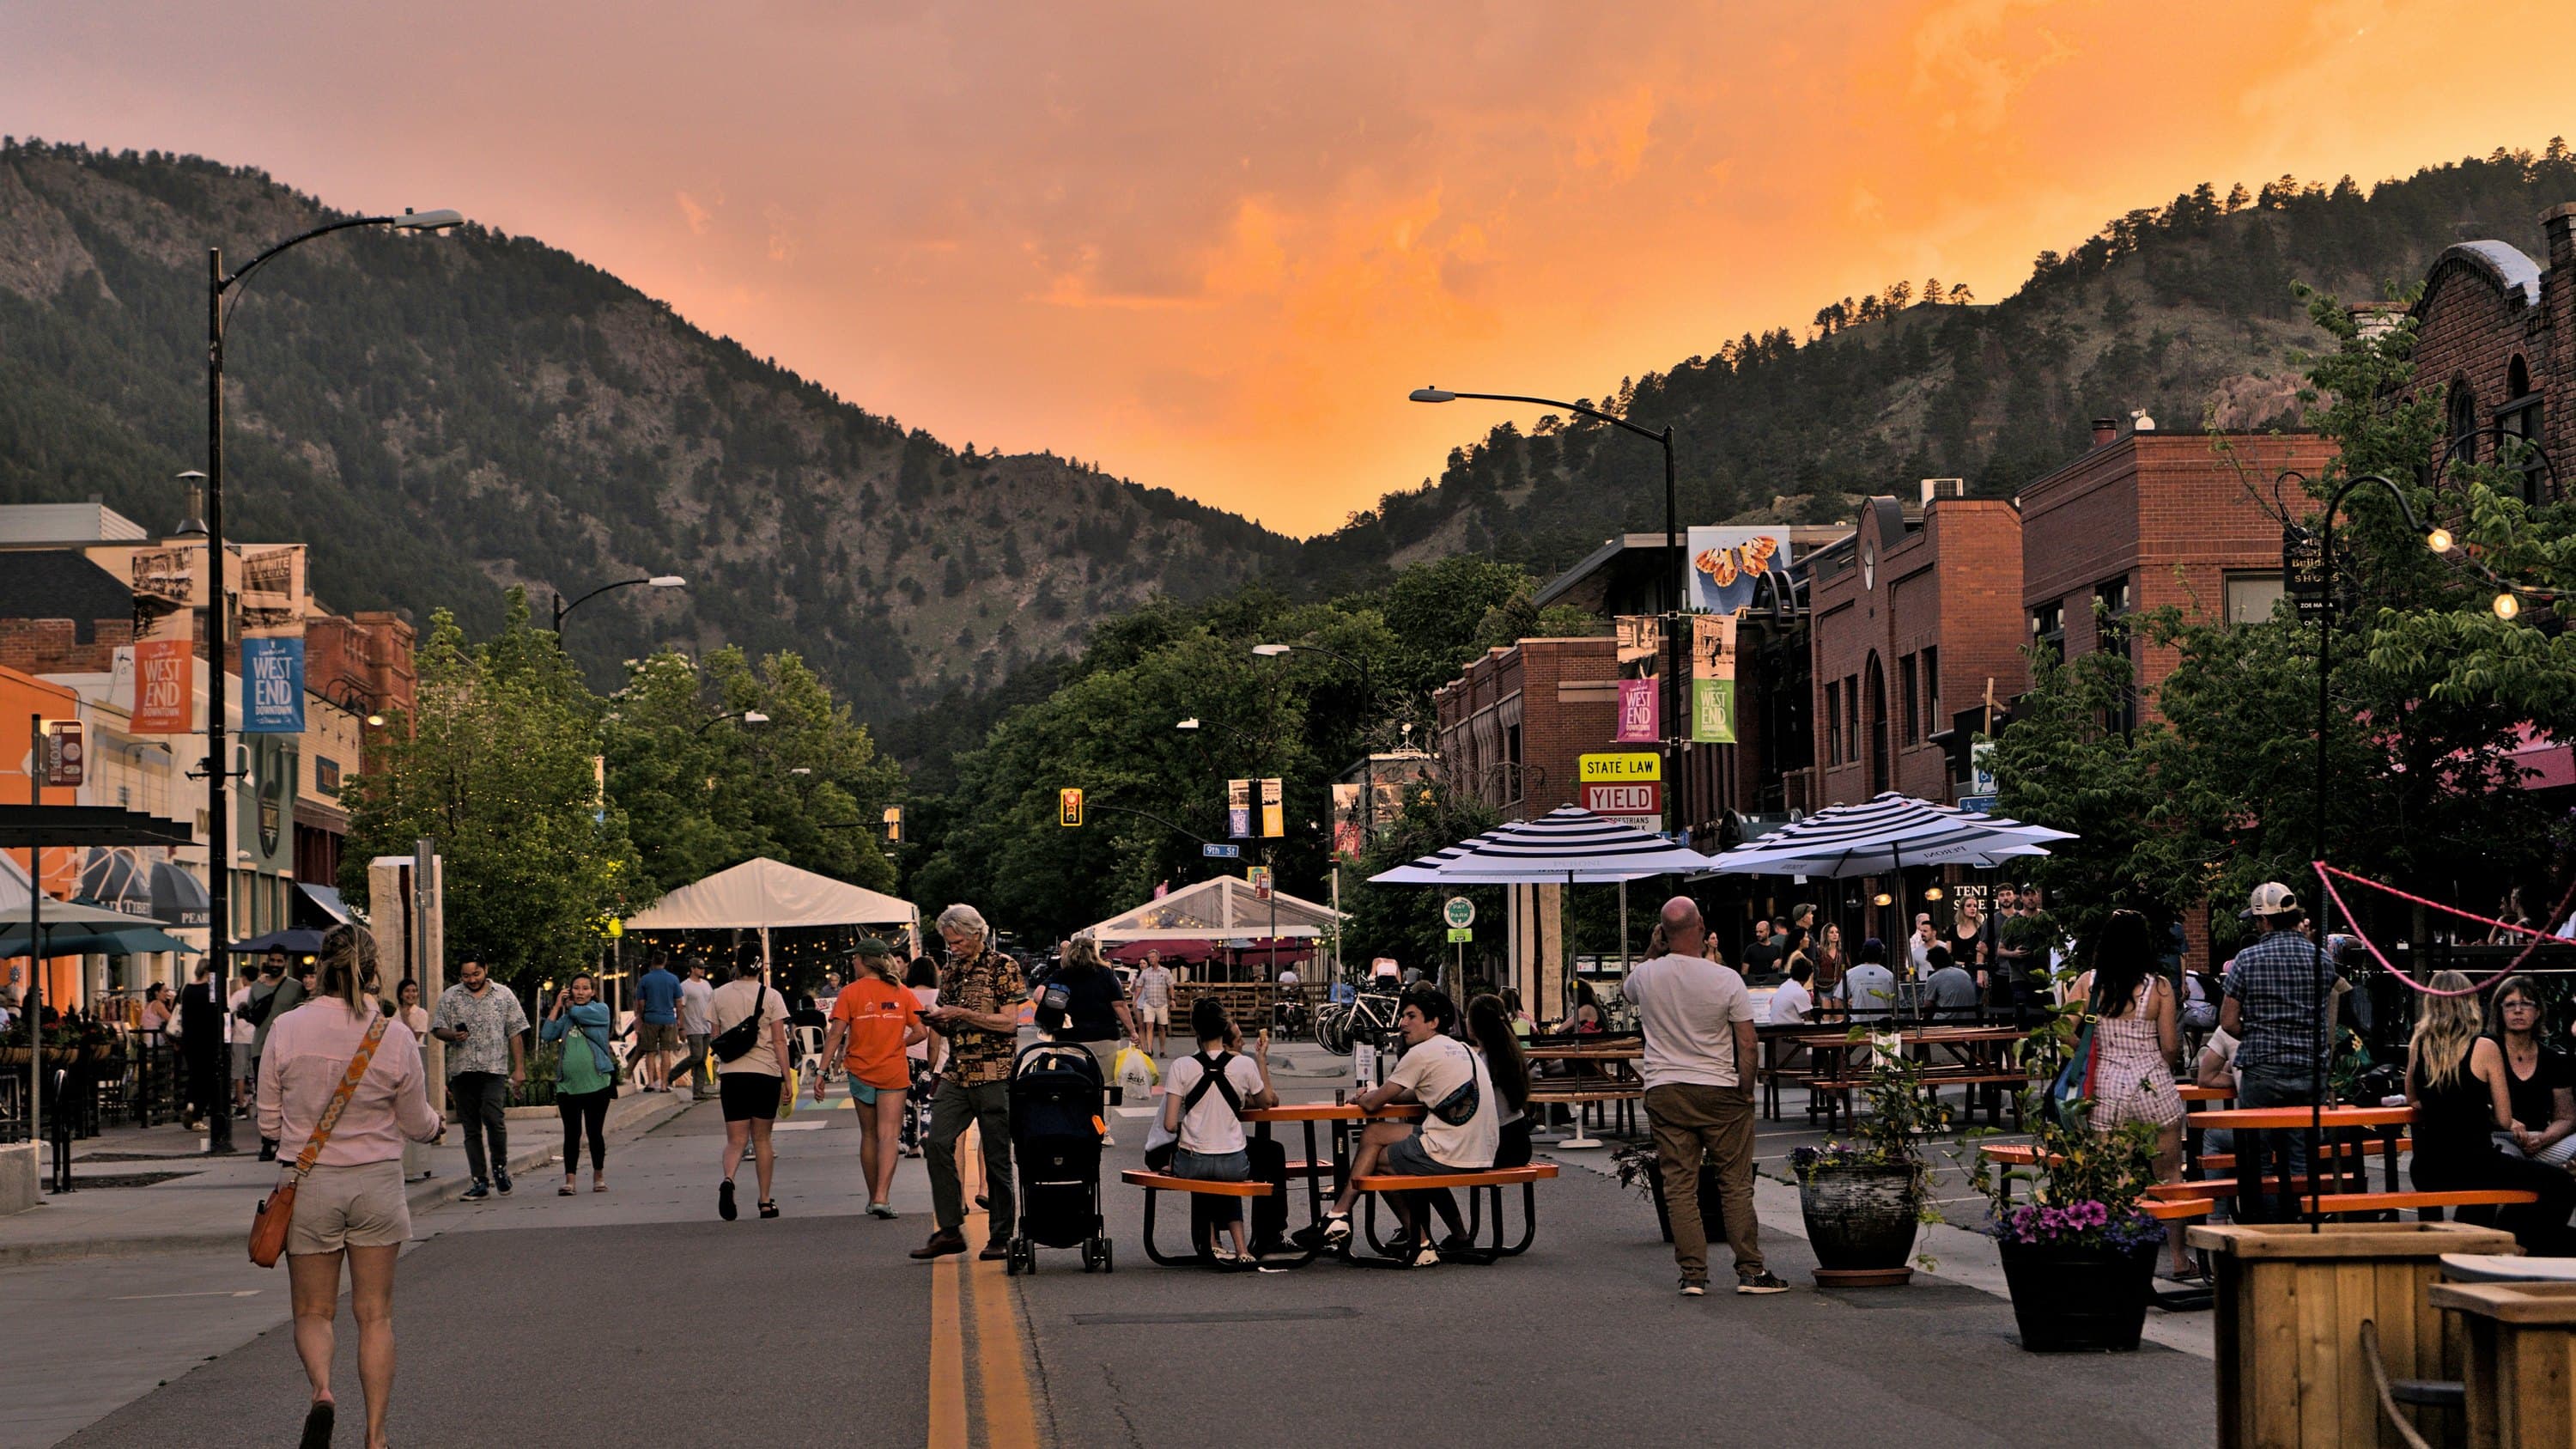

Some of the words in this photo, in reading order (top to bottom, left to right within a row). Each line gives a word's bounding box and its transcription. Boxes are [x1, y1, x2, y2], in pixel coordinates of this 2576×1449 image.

[2294, 572, 2340, 582] SHOS
[143, 658, 182, 681] WEST
[252, 656, 293, 680] WEST
[144, 681, 180, 707] END
[255, 679, 291, 705] END
[1625, 691, 1652, 708] WEST
[1700, 691, 1727, 708] WEST
[143, 707, 179, 716] DOWNTOWN
[255, 705, 292, 715] DOWNTOWN
[1626, 707, 1650, 724] END
[1702, 707, 1726, 725] END
[1587, 761, 1622, 774] STATE
[1630, 760, 1653, 773] LAW
[1593, 788, 1649, 808] YIELD
[1232, 814, 1246, 823] WEST
[1234, 822, 1246, 832] END
[1206, 846, 1220, 855] 9th
[1226, 847, 1236, 855] St
[1953, 886, 1997, 897] TENT
